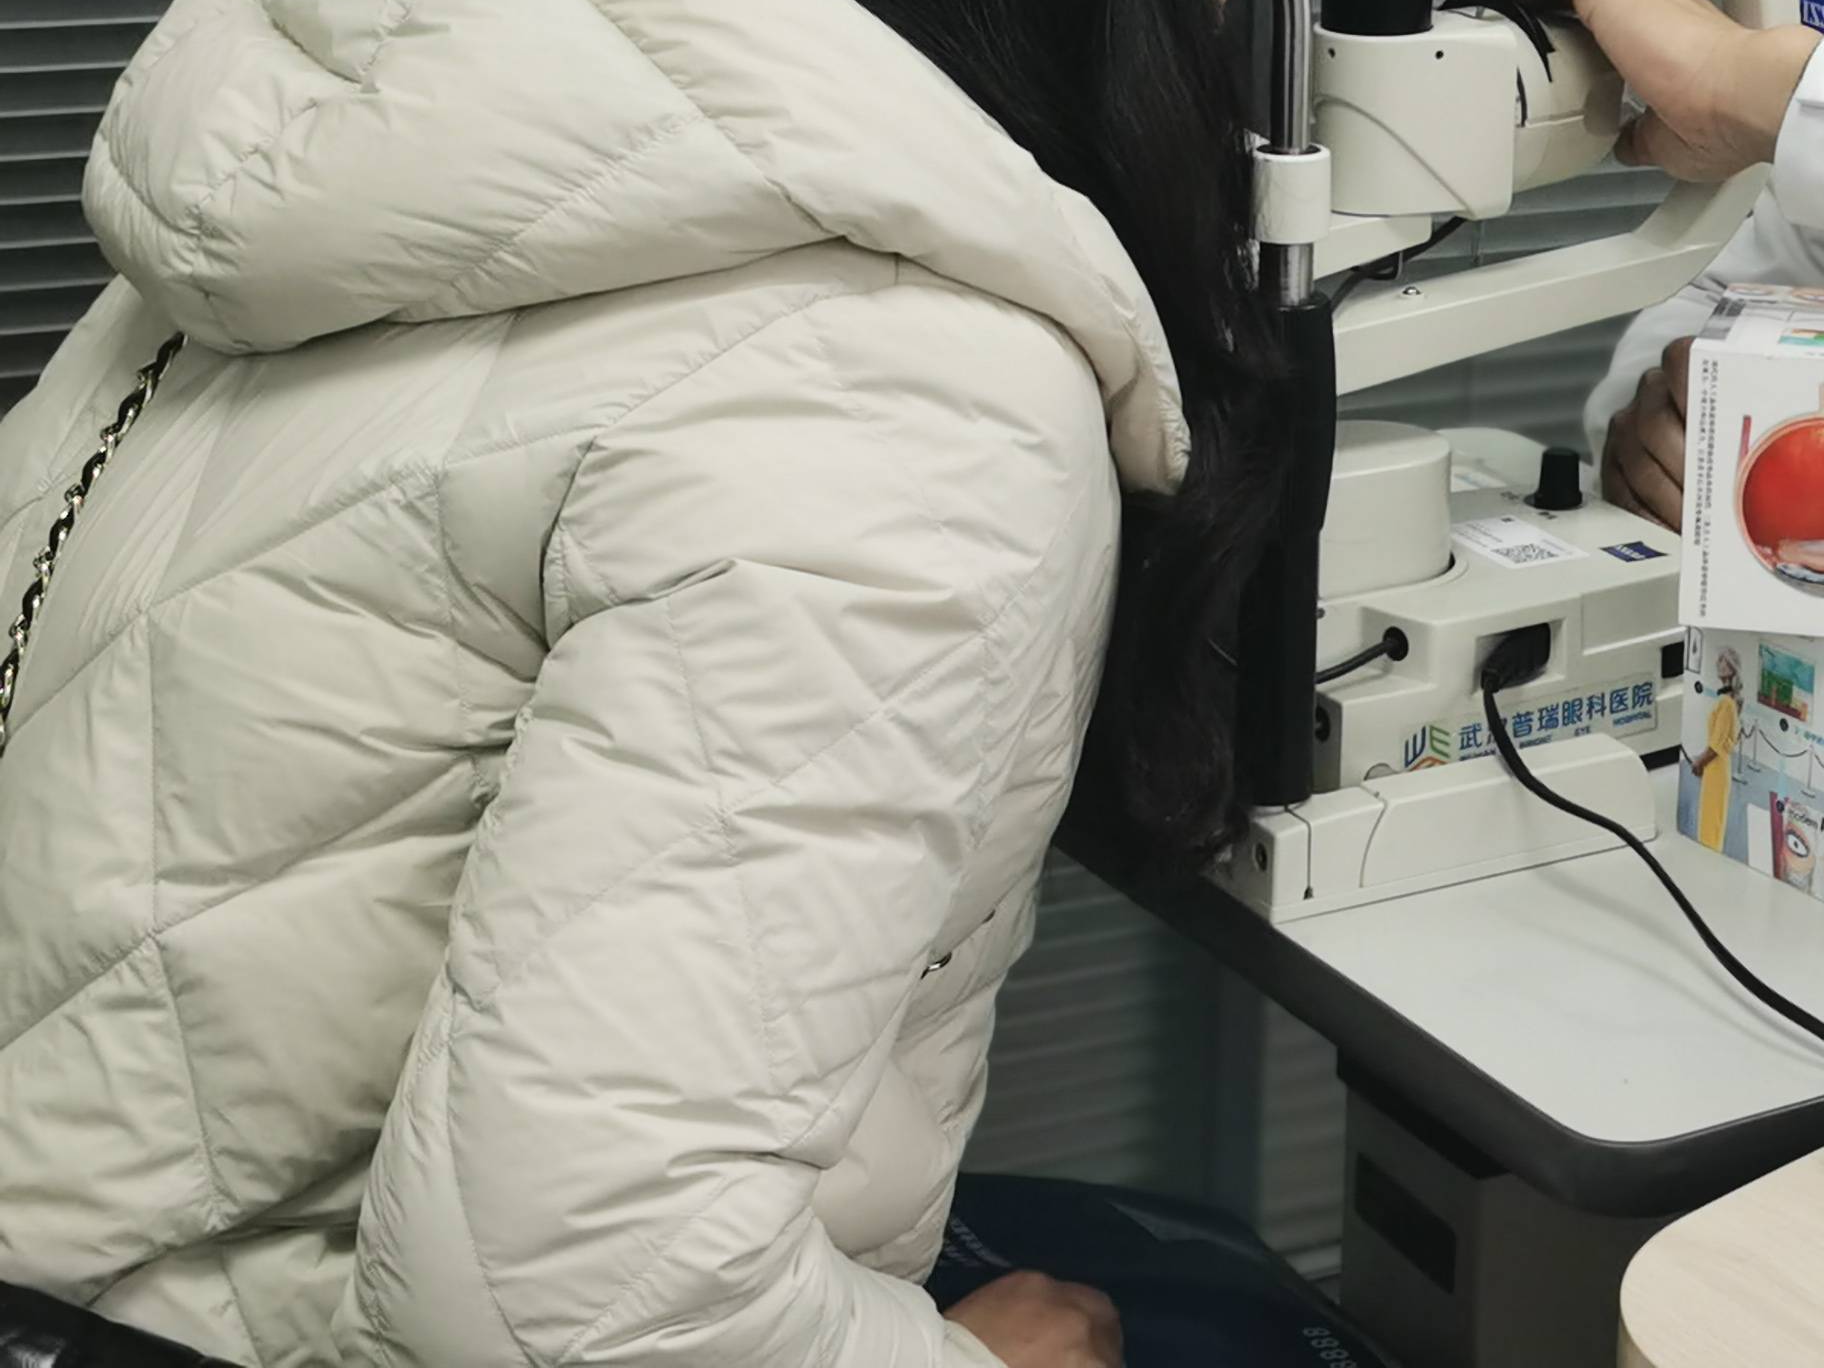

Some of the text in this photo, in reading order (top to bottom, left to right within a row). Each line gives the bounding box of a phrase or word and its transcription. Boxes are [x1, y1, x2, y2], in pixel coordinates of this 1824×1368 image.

[1458, 681, 1655, 752] 武普瑞眼科医院
